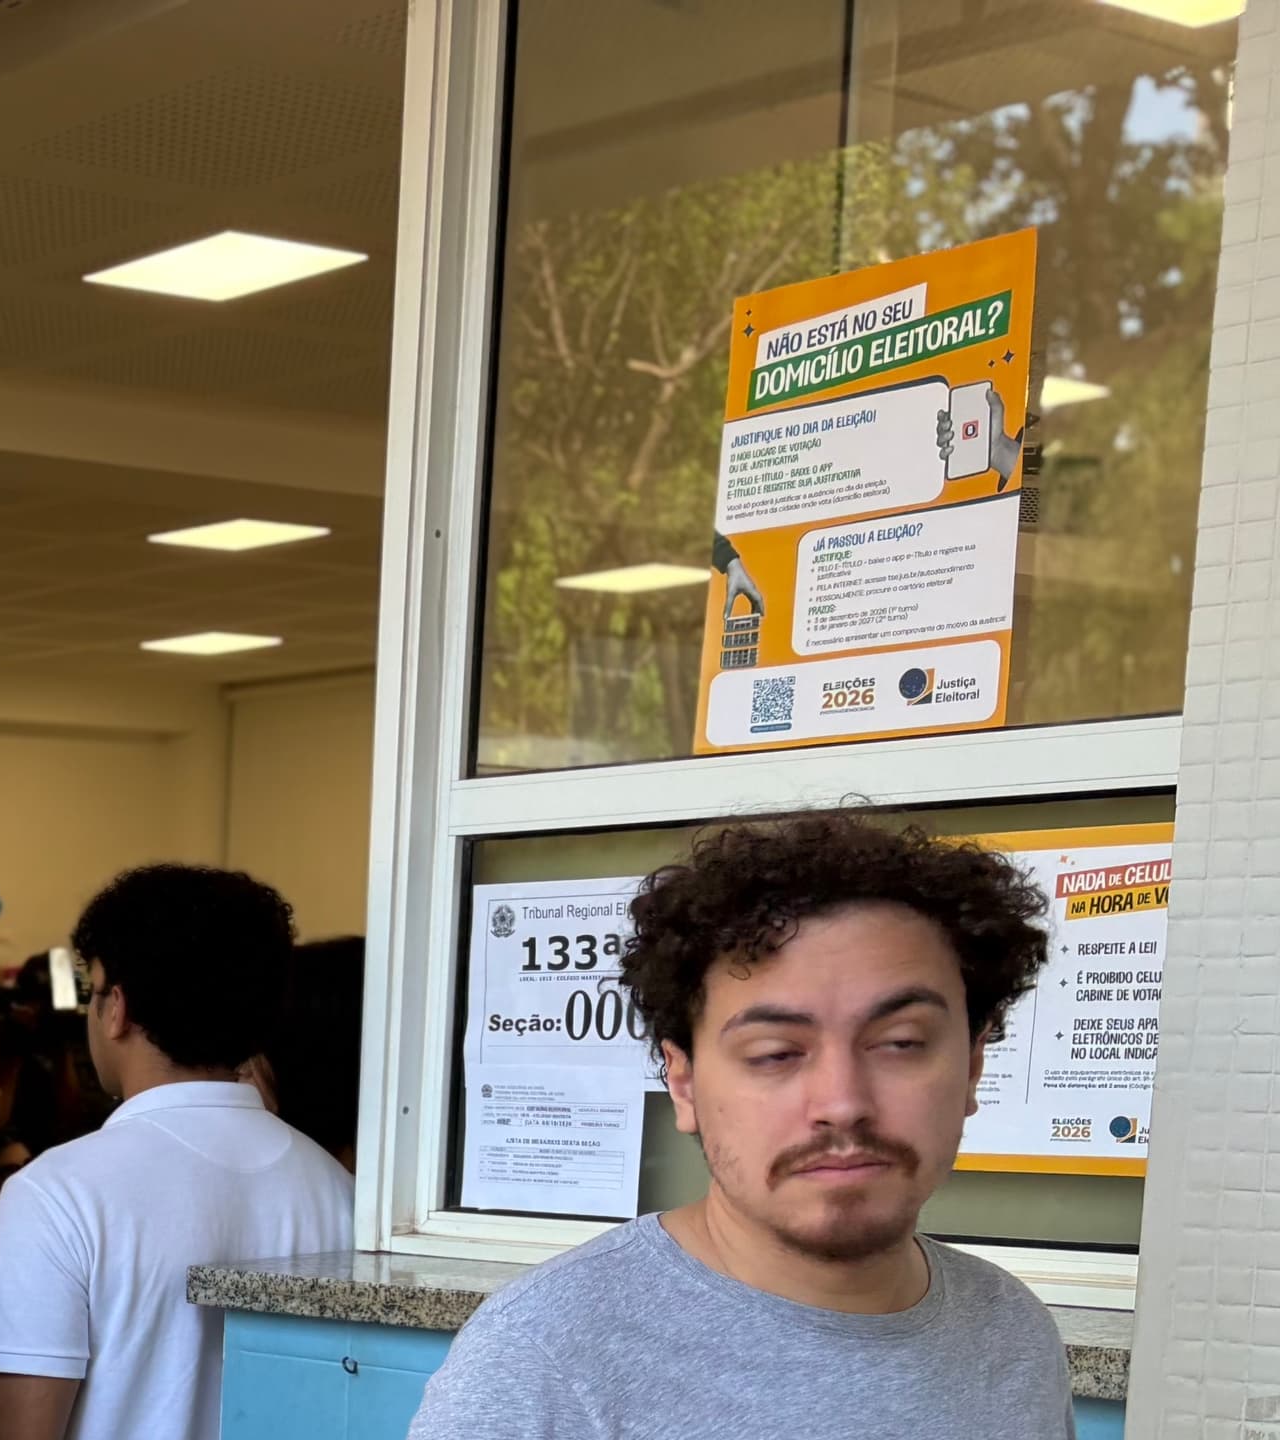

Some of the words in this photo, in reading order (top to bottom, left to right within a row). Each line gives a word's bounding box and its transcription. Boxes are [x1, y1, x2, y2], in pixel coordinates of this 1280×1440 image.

[767, 332, 802, 360] NÃO
[807, 315, 847, 348] ESTÁ
[853, 310, 877, 335] NO
[882, 298, 913, 325] SEU
[755, 343, 863, 400] DOMICÍLIO
[869, 300, 1004, 368] ELEITORAL?
[732, 428, 782, 448] JUSTIFIQUE
[786, 426, 799, 436] NO
[803, 421, 818, 434] DIA
[822, 419, 833, 431] DA
[837, 410, 876, 427] ELEIÇÃO!
[790, 439, 821, 451] VOTAÇÃO
[813, 537, 825, 552] JÁ
[828, 532, 865, 549] PASSOU
[868, 530, 874, 542] A
[878, 523, 923, 541] ELEIÇÃO?
[823, 677, 875, 691] ELEIÇÕES
[937, 677, 976, 689] Justiça
[822, 689, 874, 708] 2026
[935, 689, 979, 703] Eleitoral
[1063, 872, 1105, 894] NADA
[1109, 874, 1122, 886] DE
[1072, 902, 1085, 914] NA
[1089, 892, 1133, 915] HORA
[1137, 892, 1151, 905] DE
[523, 905, 563, 920] Tribunal
[567, 904, 612, 920] Regional
[1078, 943, 1125, 955] RESPEITE
[1129, 942, 1136, 954] A
[1140, 941, 1156, 954] LEI!
[1077, 971, 1083, 984] É
[1086, 971, 1133, 984] PROIBIDO
[1076, 989, 1113, 1001] CABINE
[1117, 989, 1129, 1000] DE
[1133, 989, 1161, 1000] VOTA
[488, 1014, 561, 1036] Seção:
[1073, 1019, 1102, 1030] DEIXE
[1106, 1018, 1134, 1030] SEUS
[1072, 1031, 1143, 1045] ELETRÔNICOS
[1071, 1049, 1086, 1060] NO
[1090, 1048, 1121, 1060] LOCAL
[1052, 1118, 1091, 1126] ELEIÇÕES
[1052, 1126, 1091, 1137] 2026
